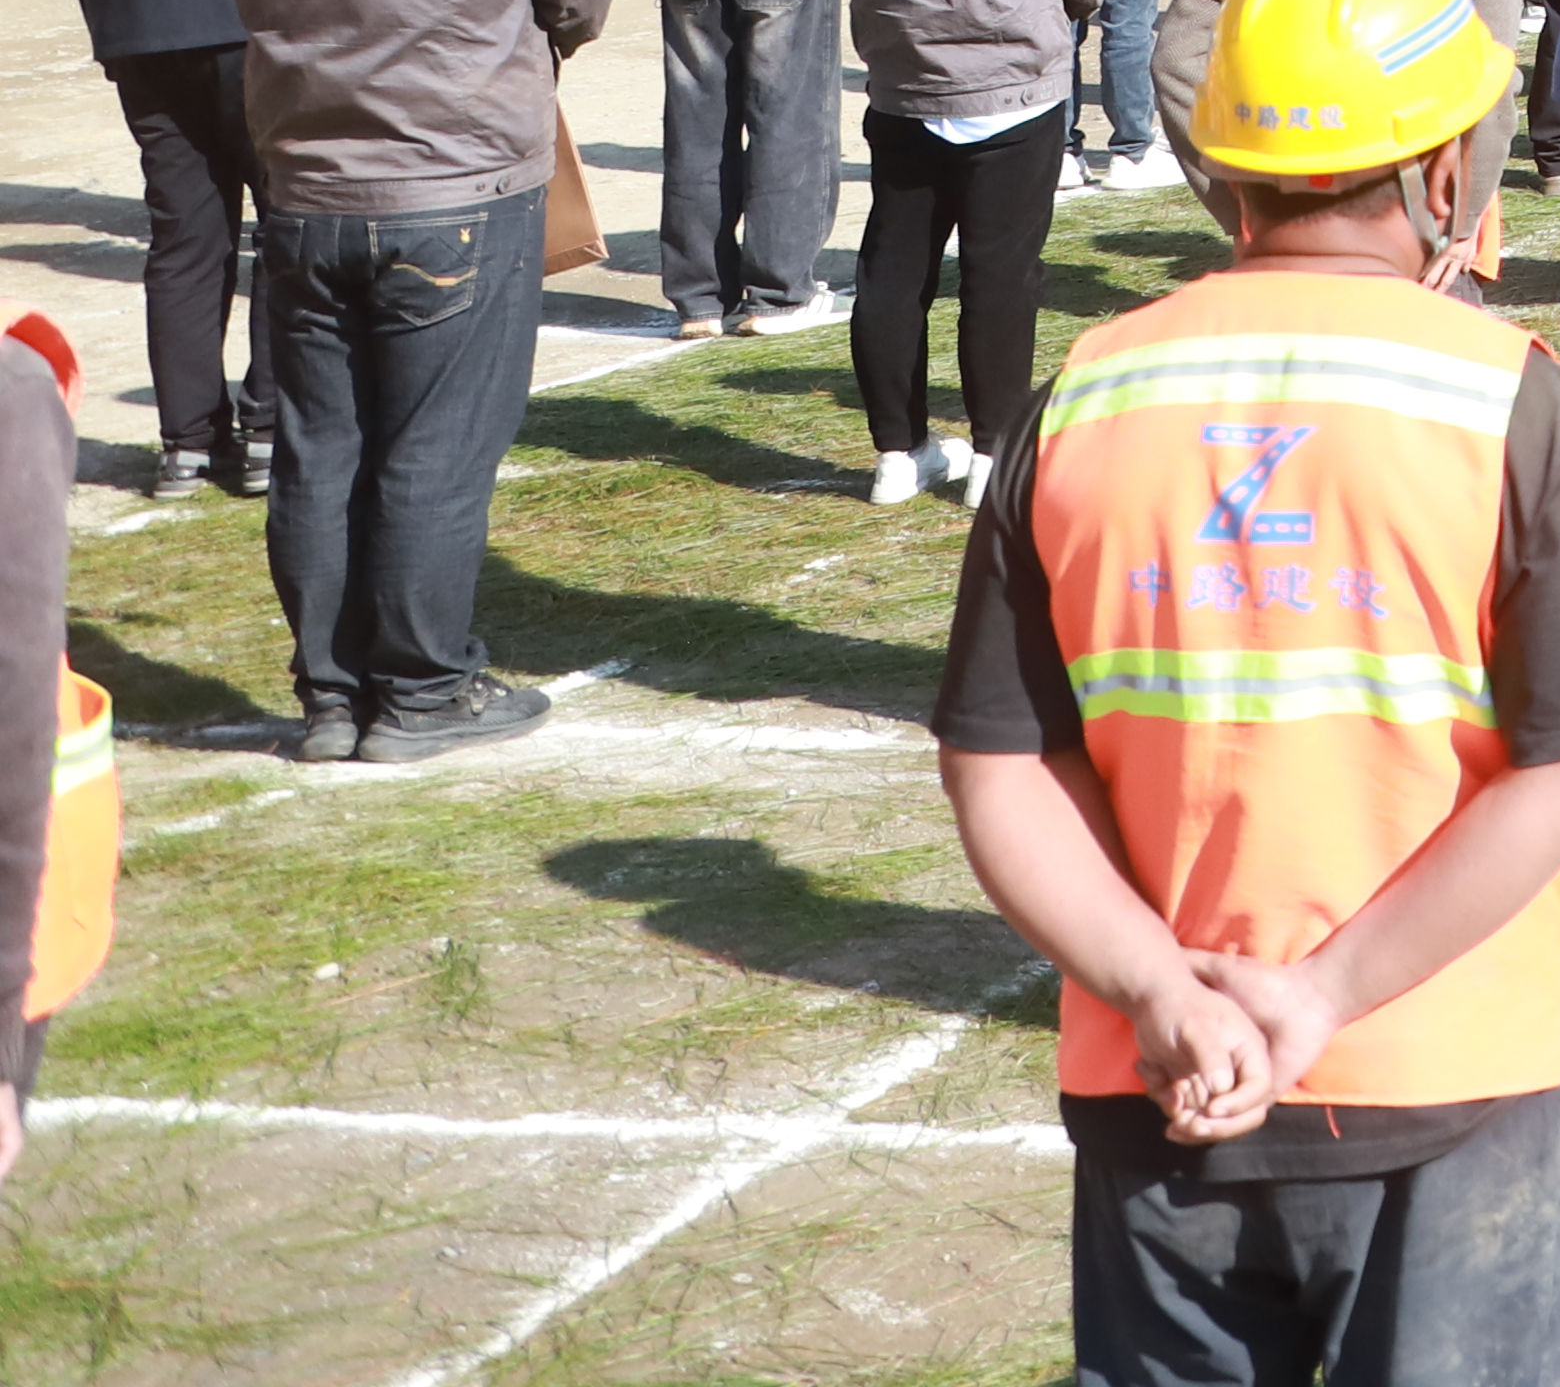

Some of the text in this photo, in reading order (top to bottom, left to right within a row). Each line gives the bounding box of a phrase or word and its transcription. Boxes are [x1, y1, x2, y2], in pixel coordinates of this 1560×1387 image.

[1233, 102, 1348, 129] 中路建设
[1128, 561, 1390, 619] 中路建设
